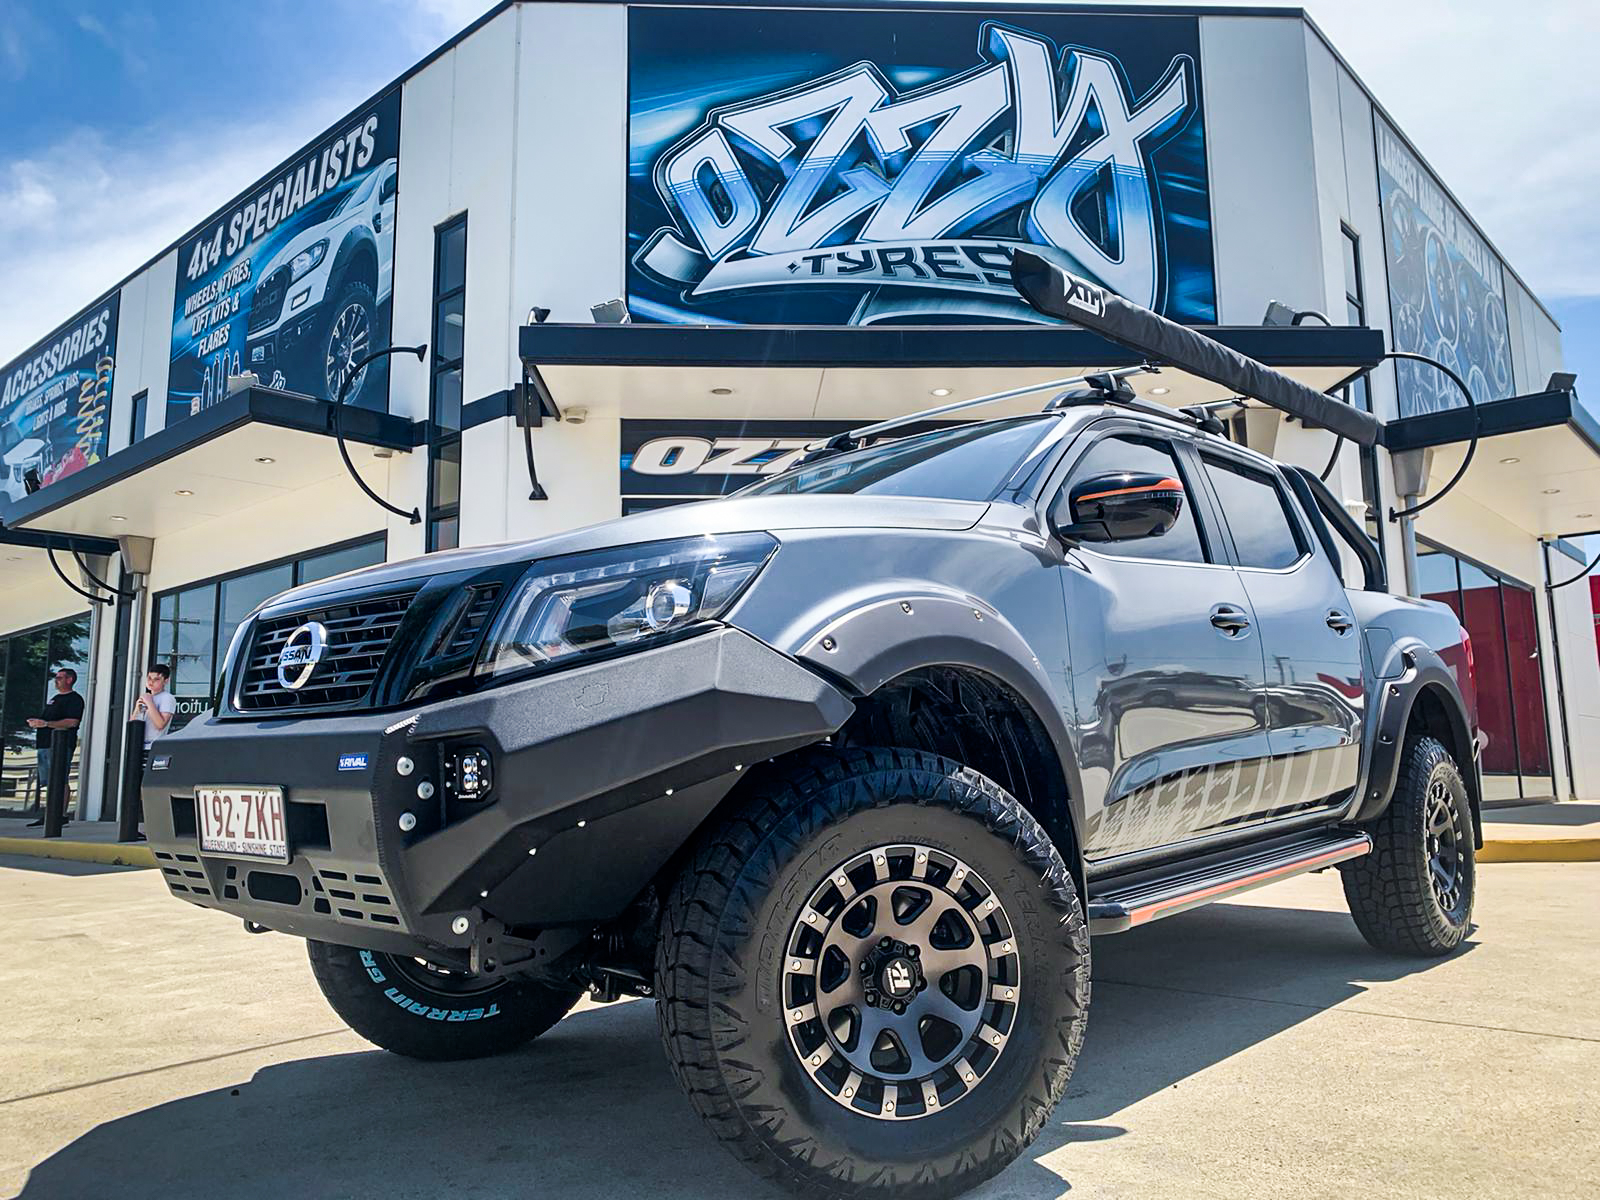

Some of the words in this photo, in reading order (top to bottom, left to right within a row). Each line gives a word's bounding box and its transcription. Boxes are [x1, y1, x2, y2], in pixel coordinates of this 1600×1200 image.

[226, 114, 379, 256] SPECIALISTS
[802, 244, 1015, 286] TYRES
[192, 310, 211, 337] LIFT
[210, 297, 231, 326] KITS
[232, 291, 240, 313] &
[0, 308, 110, 409] ACCESSORIES
[197, 324, 231, 358] FLARES
[630, 436, 833, 475] OZZ
[269, 844, 287, 857] STATE
[383, 986, 501, 1022] TERRAIN
